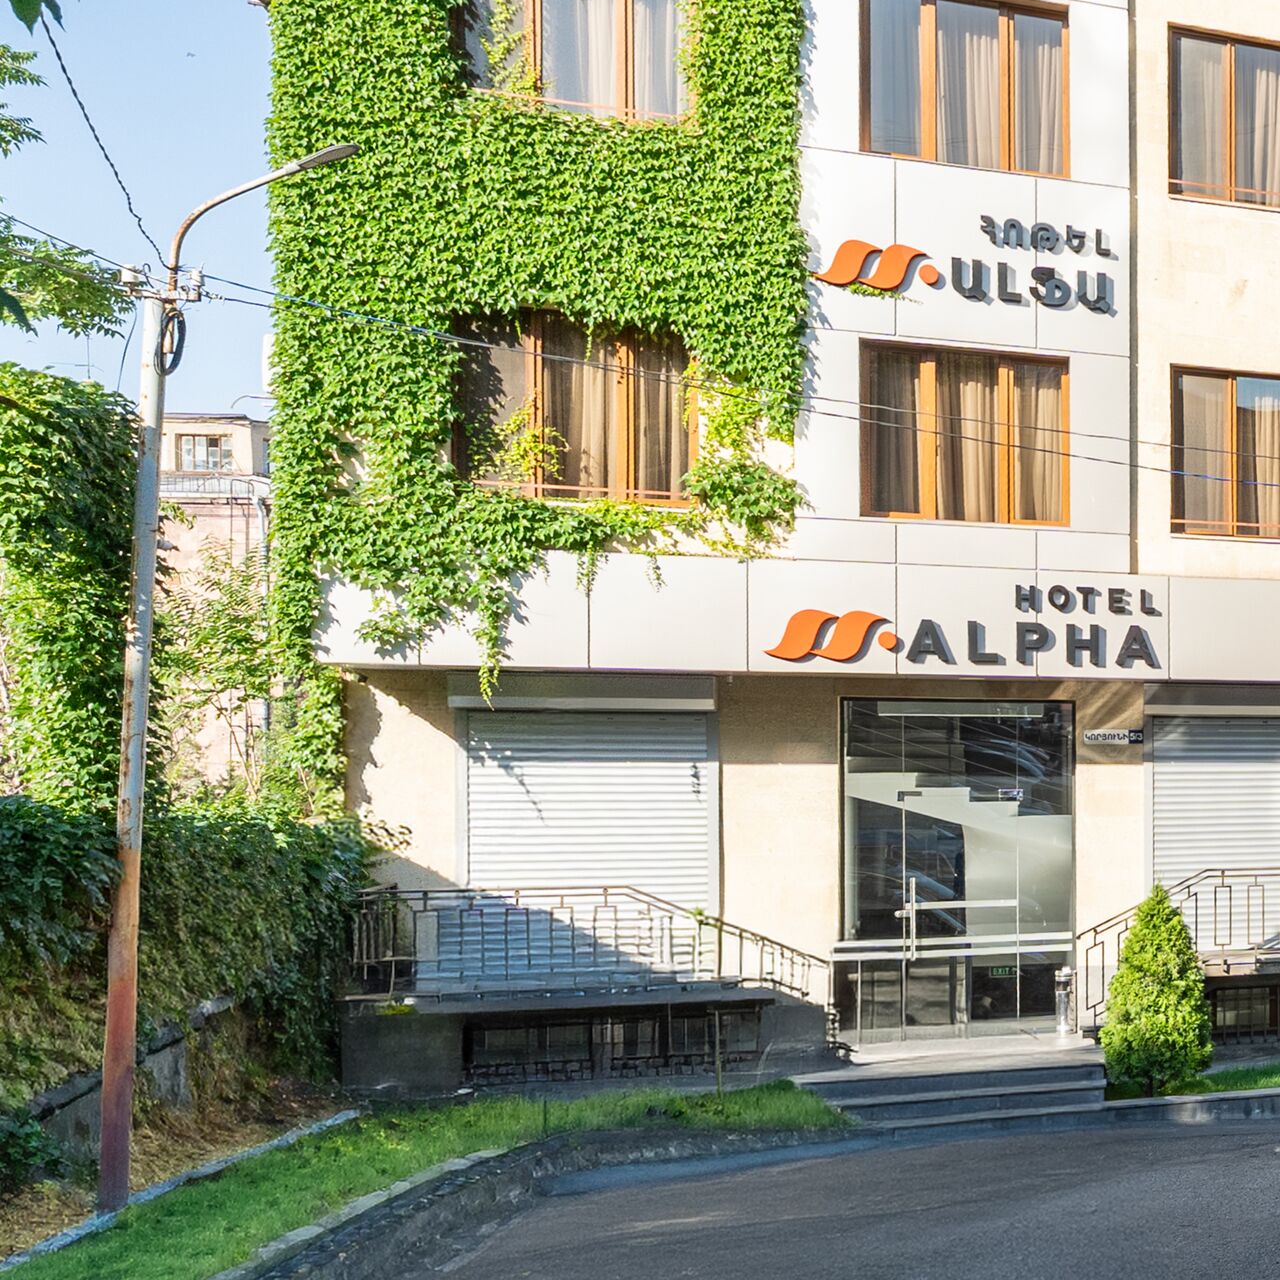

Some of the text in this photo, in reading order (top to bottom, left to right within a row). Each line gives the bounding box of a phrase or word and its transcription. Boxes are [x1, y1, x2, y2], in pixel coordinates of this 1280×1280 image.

[980, 214, 1112, 257] ՀՈԹԵԼ
[951, 256, 1111, 315] ԱԼՖԱ
[1015, 584, 1160, 616] HOTEL
[905, 618, 1161, 669] ALPHA
[992, 967, 1010, 975] EXIT
